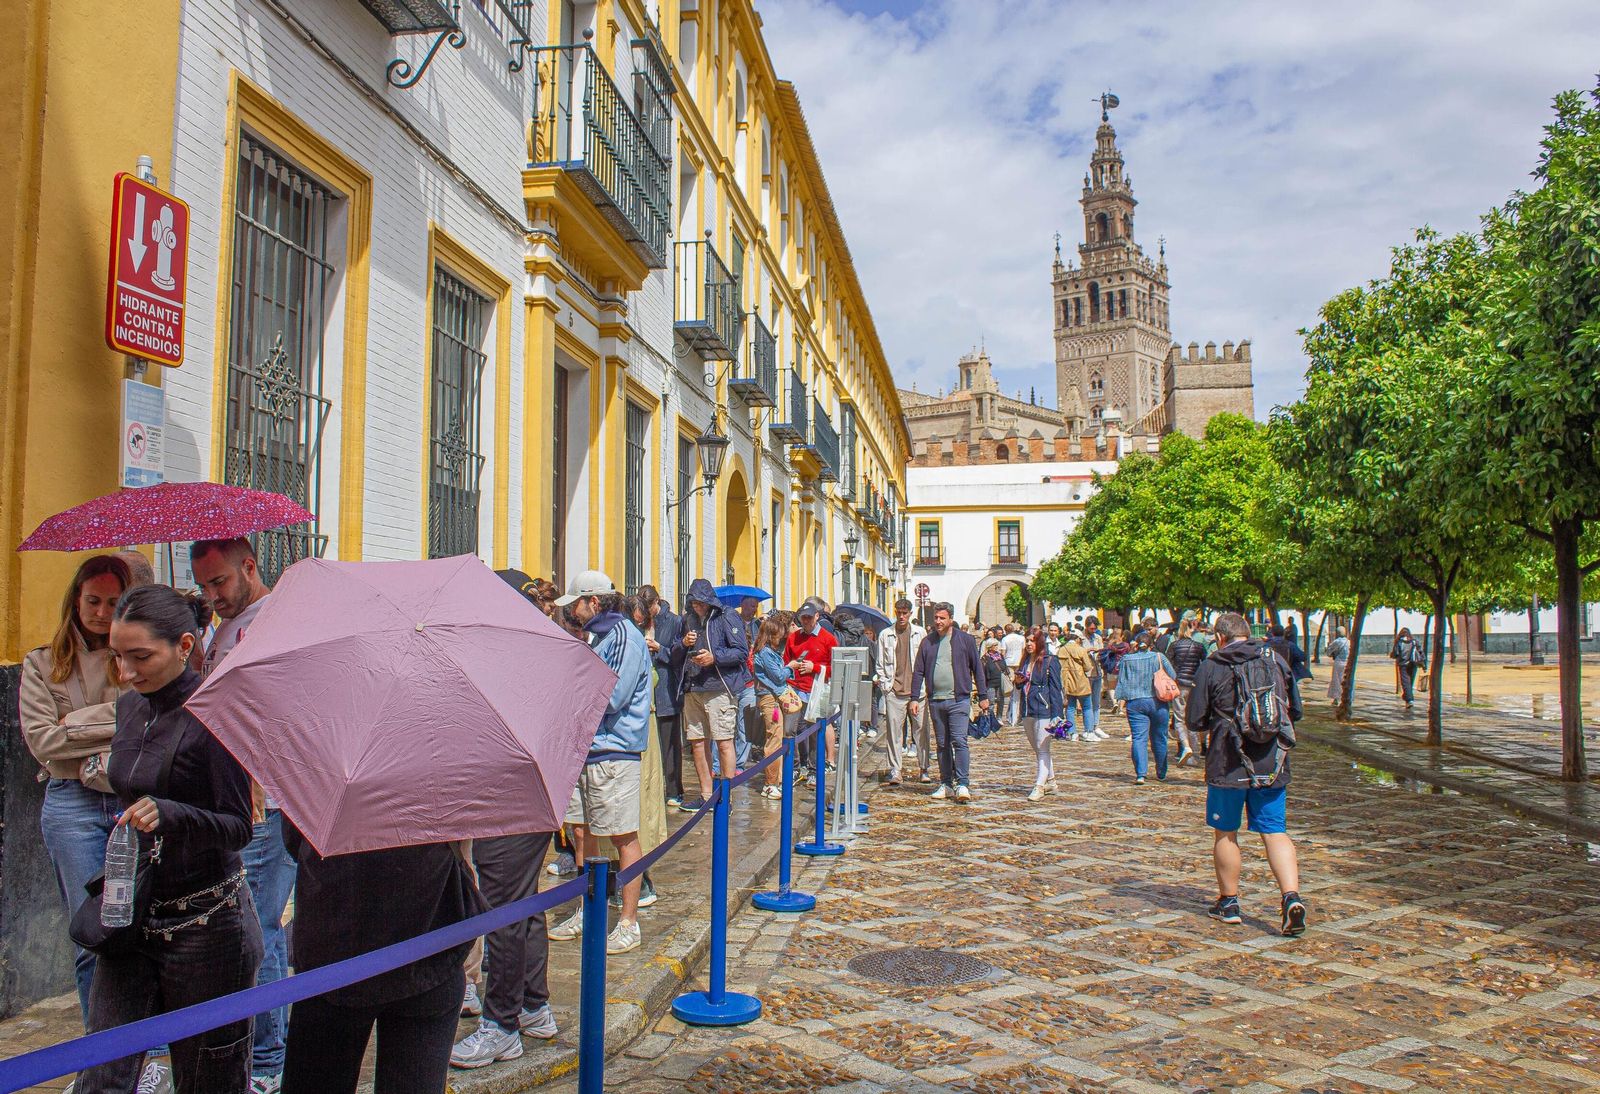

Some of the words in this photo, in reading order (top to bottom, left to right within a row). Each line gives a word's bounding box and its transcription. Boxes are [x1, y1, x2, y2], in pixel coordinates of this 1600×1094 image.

[120, 293, 179, 325] HIDRANTE
[569, 312, 573, 327] 5
[124, 312, 174, 339] CONTRA
[116, 325, 179, 356] INCENDIOS
